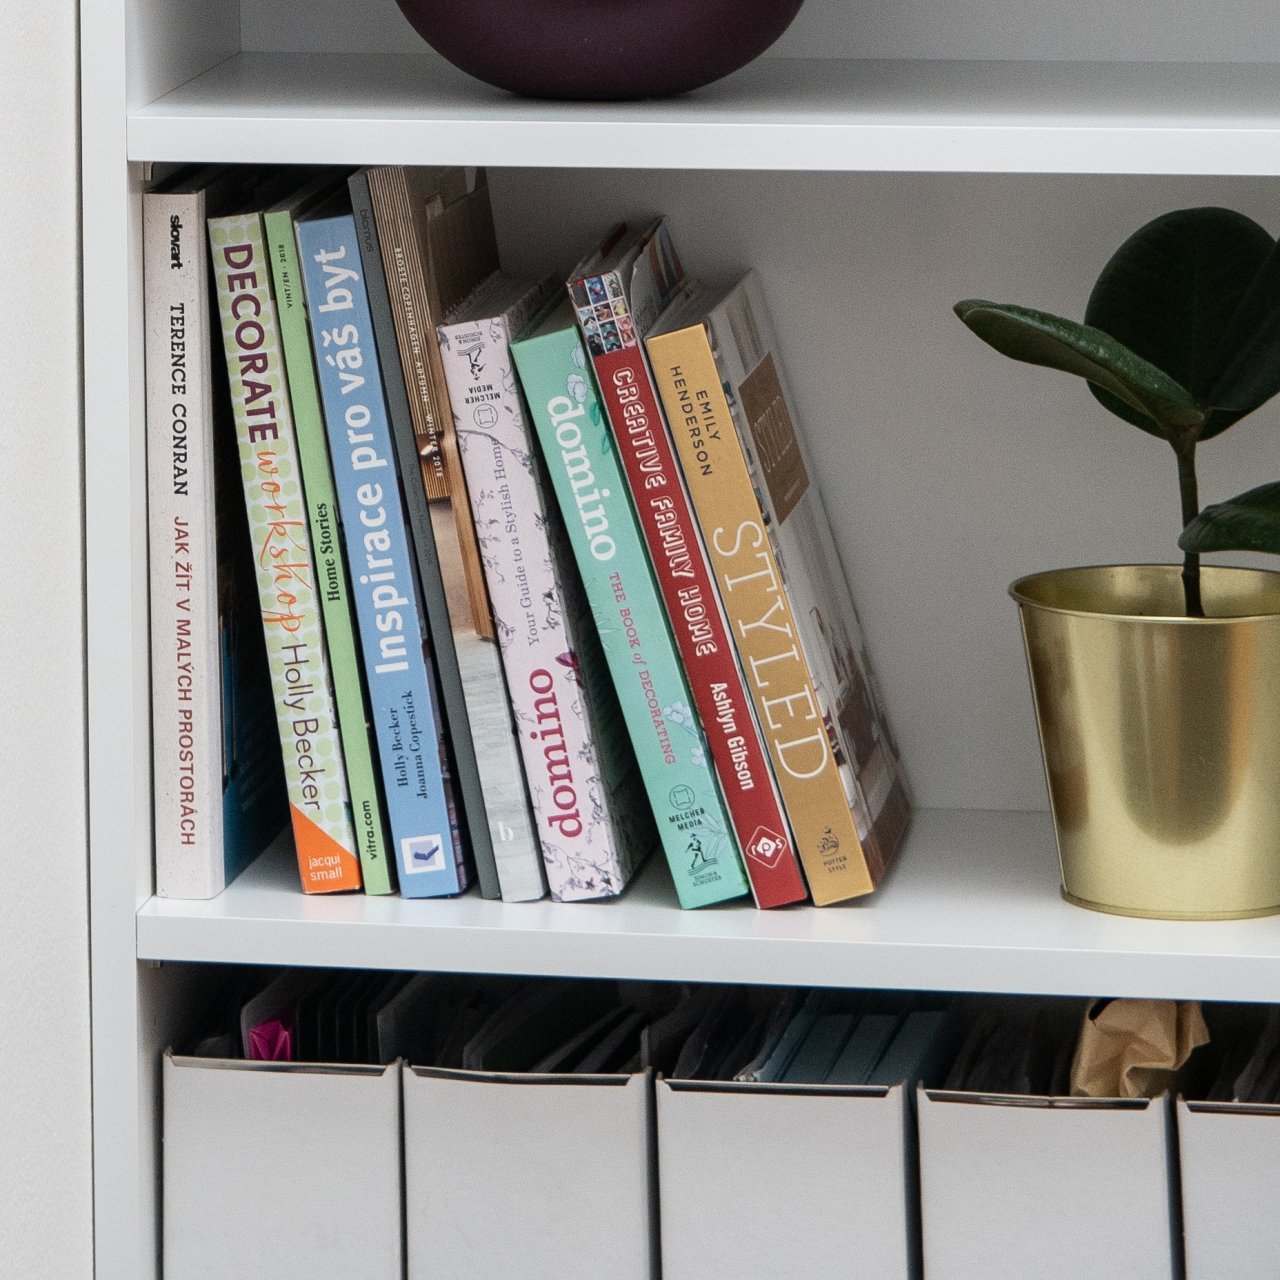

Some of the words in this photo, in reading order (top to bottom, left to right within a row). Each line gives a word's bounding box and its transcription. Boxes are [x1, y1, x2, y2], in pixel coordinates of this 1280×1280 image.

[169, 214, 183, 269] slovart
[277, 243, 287, 263] 2018
[281, 270, 292, 308] VINT/EN
[314, 246, 359, 312] byt
[169, 302, 186, 394] TERENCE
[223, 244, 277, 441] DECORATE
[321, 324, 364, 394] váš
[464, 391, 501, 404] MELCHER
[468, 383, 493, 394] MEDIA
[344, 404, 387, 470] pro
[670, 365, 712, 476] HENDERSON
[695, 389, 720, 440] EMILY
[171, 403, 188, 495] CONRAN
[490, 437, 506, 480] Home
[547, 396, 616, 561] domino
[315, 502, 333, 554] Stories
[497, 483, 517, 533] Stylish
[257, 445, 318, 645] workshop
[510, 536, 520, 545] a
[512, 547, 523, 562] to
[324, 558, 340, 601] Home
[357, 484, 408, 673] Inspirace
[514, 565, 532, 608] Guide
[608, 571, 626, 603] THE
[525, 611, 540, 647] Your
[619, 607, 640, 648] BOOK
[713, 522, 829, 778] STYLED
[281, 643, 313, 710] Holly
[631, 651, 647, 665] of
[638, 669, 675, 764] DECORATING
[710, 682, 736, 733] Ashlyn
[727, 735, 754, 790] Gibson
[292, 717, 325, 809] Becker
[529, 668, 582, 837] domino
[361, 799, 377, 860] vitra.com
[669, 807, 705, 824] MELCHER
[677, 819, 703, 831] MEDIA
[308, 852, 340, 870] jacqui
[310, 866, 342, 881] small
